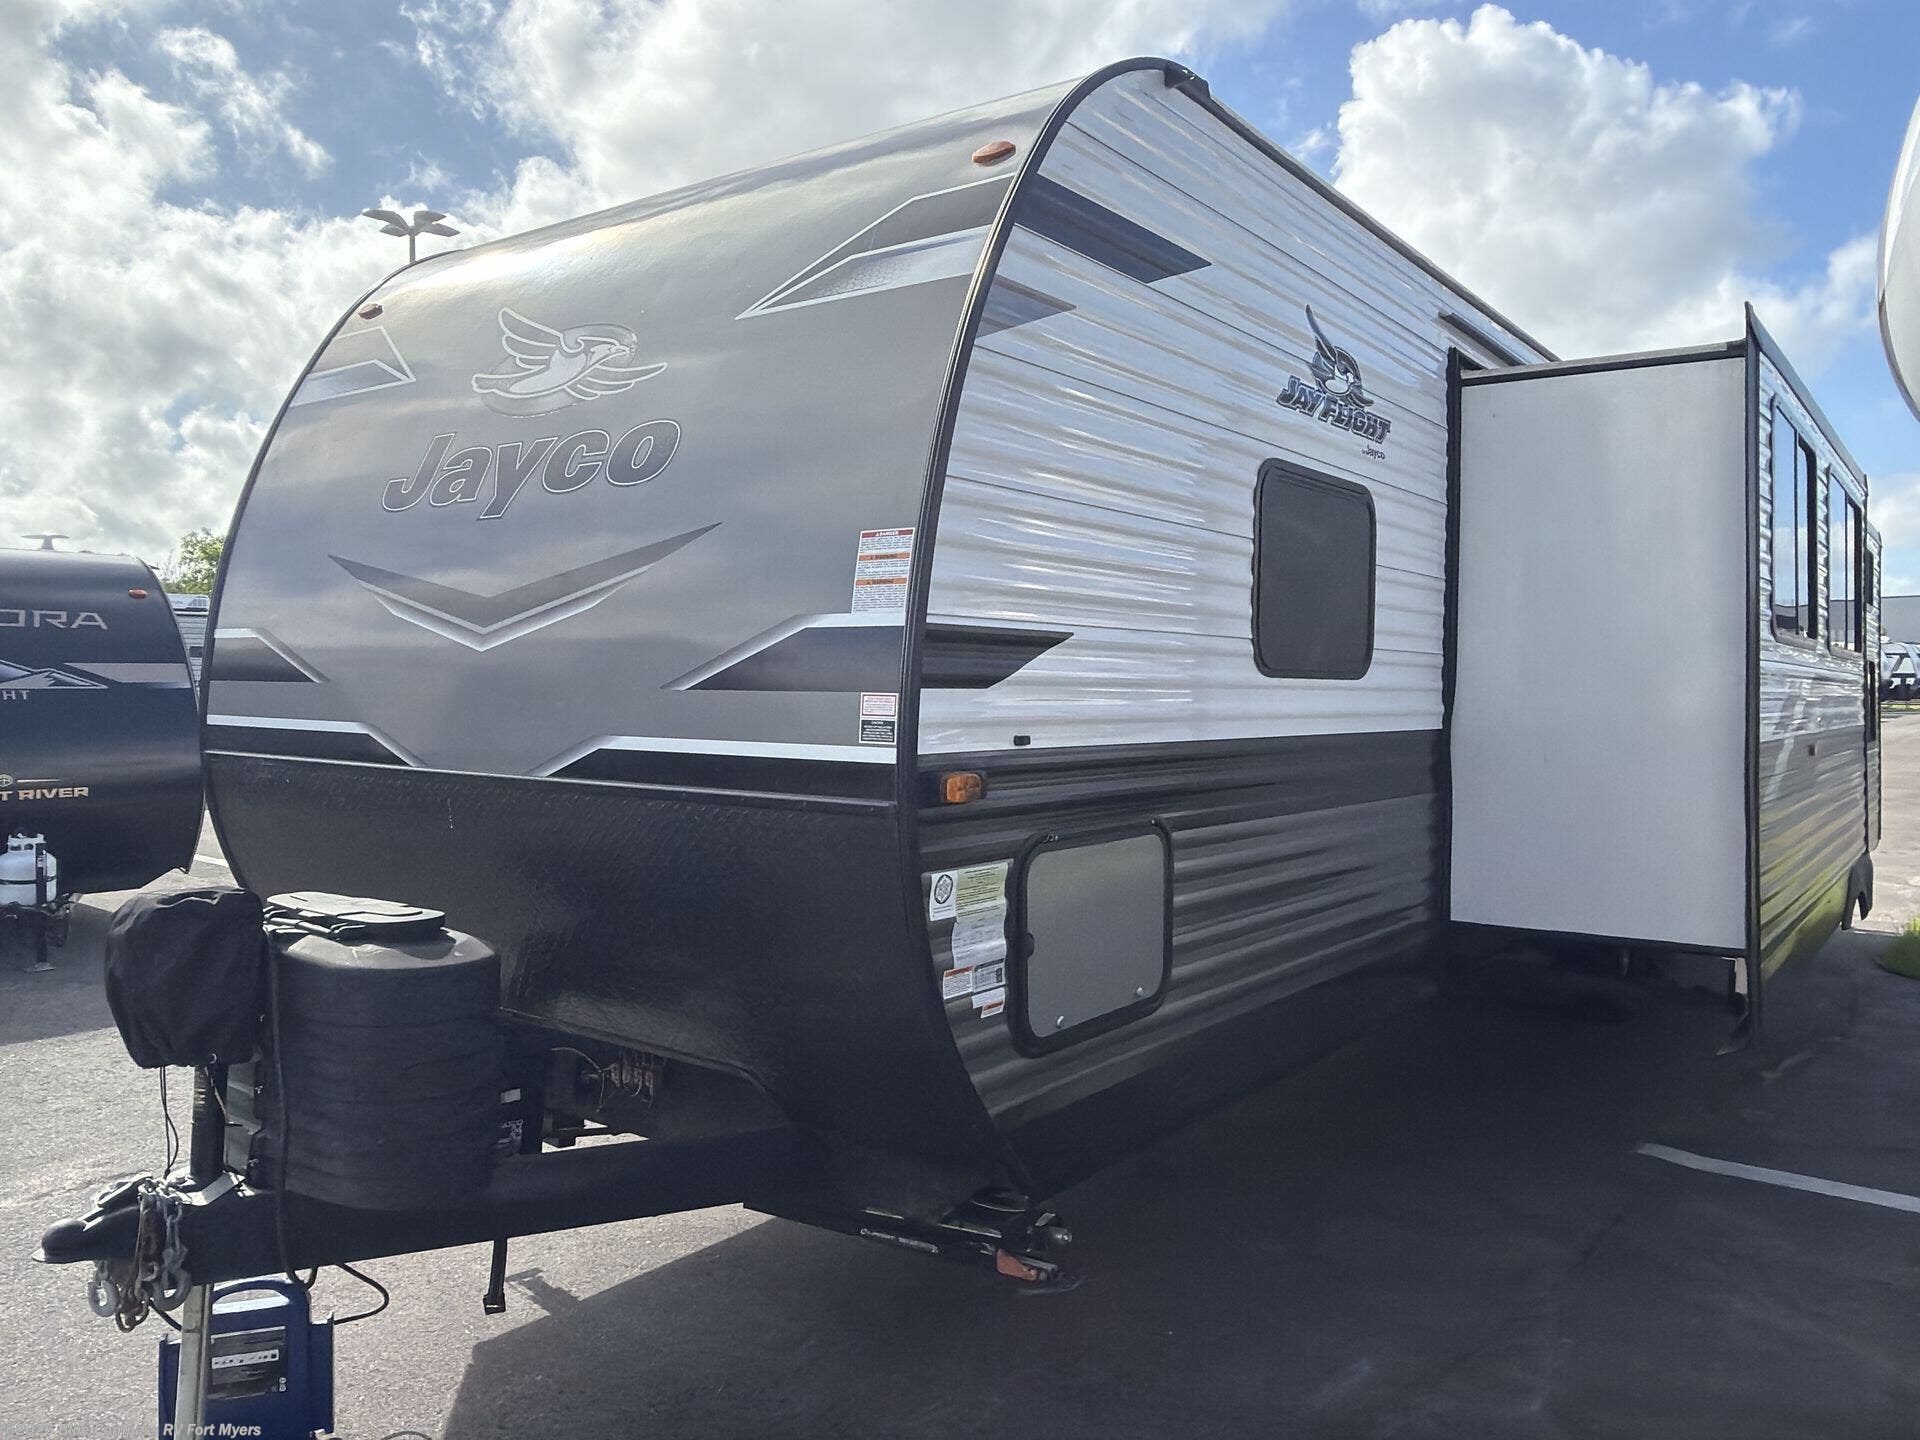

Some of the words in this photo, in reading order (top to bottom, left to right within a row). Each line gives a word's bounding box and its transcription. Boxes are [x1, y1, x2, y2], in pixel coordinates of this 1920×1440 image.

[1276, 375, 1326, 417] JAY
[1317, 396, 1392, 444] FLIGHT
[382, 419, 682, 520] Jayco
[18, 786, 89, 801] RIVER
